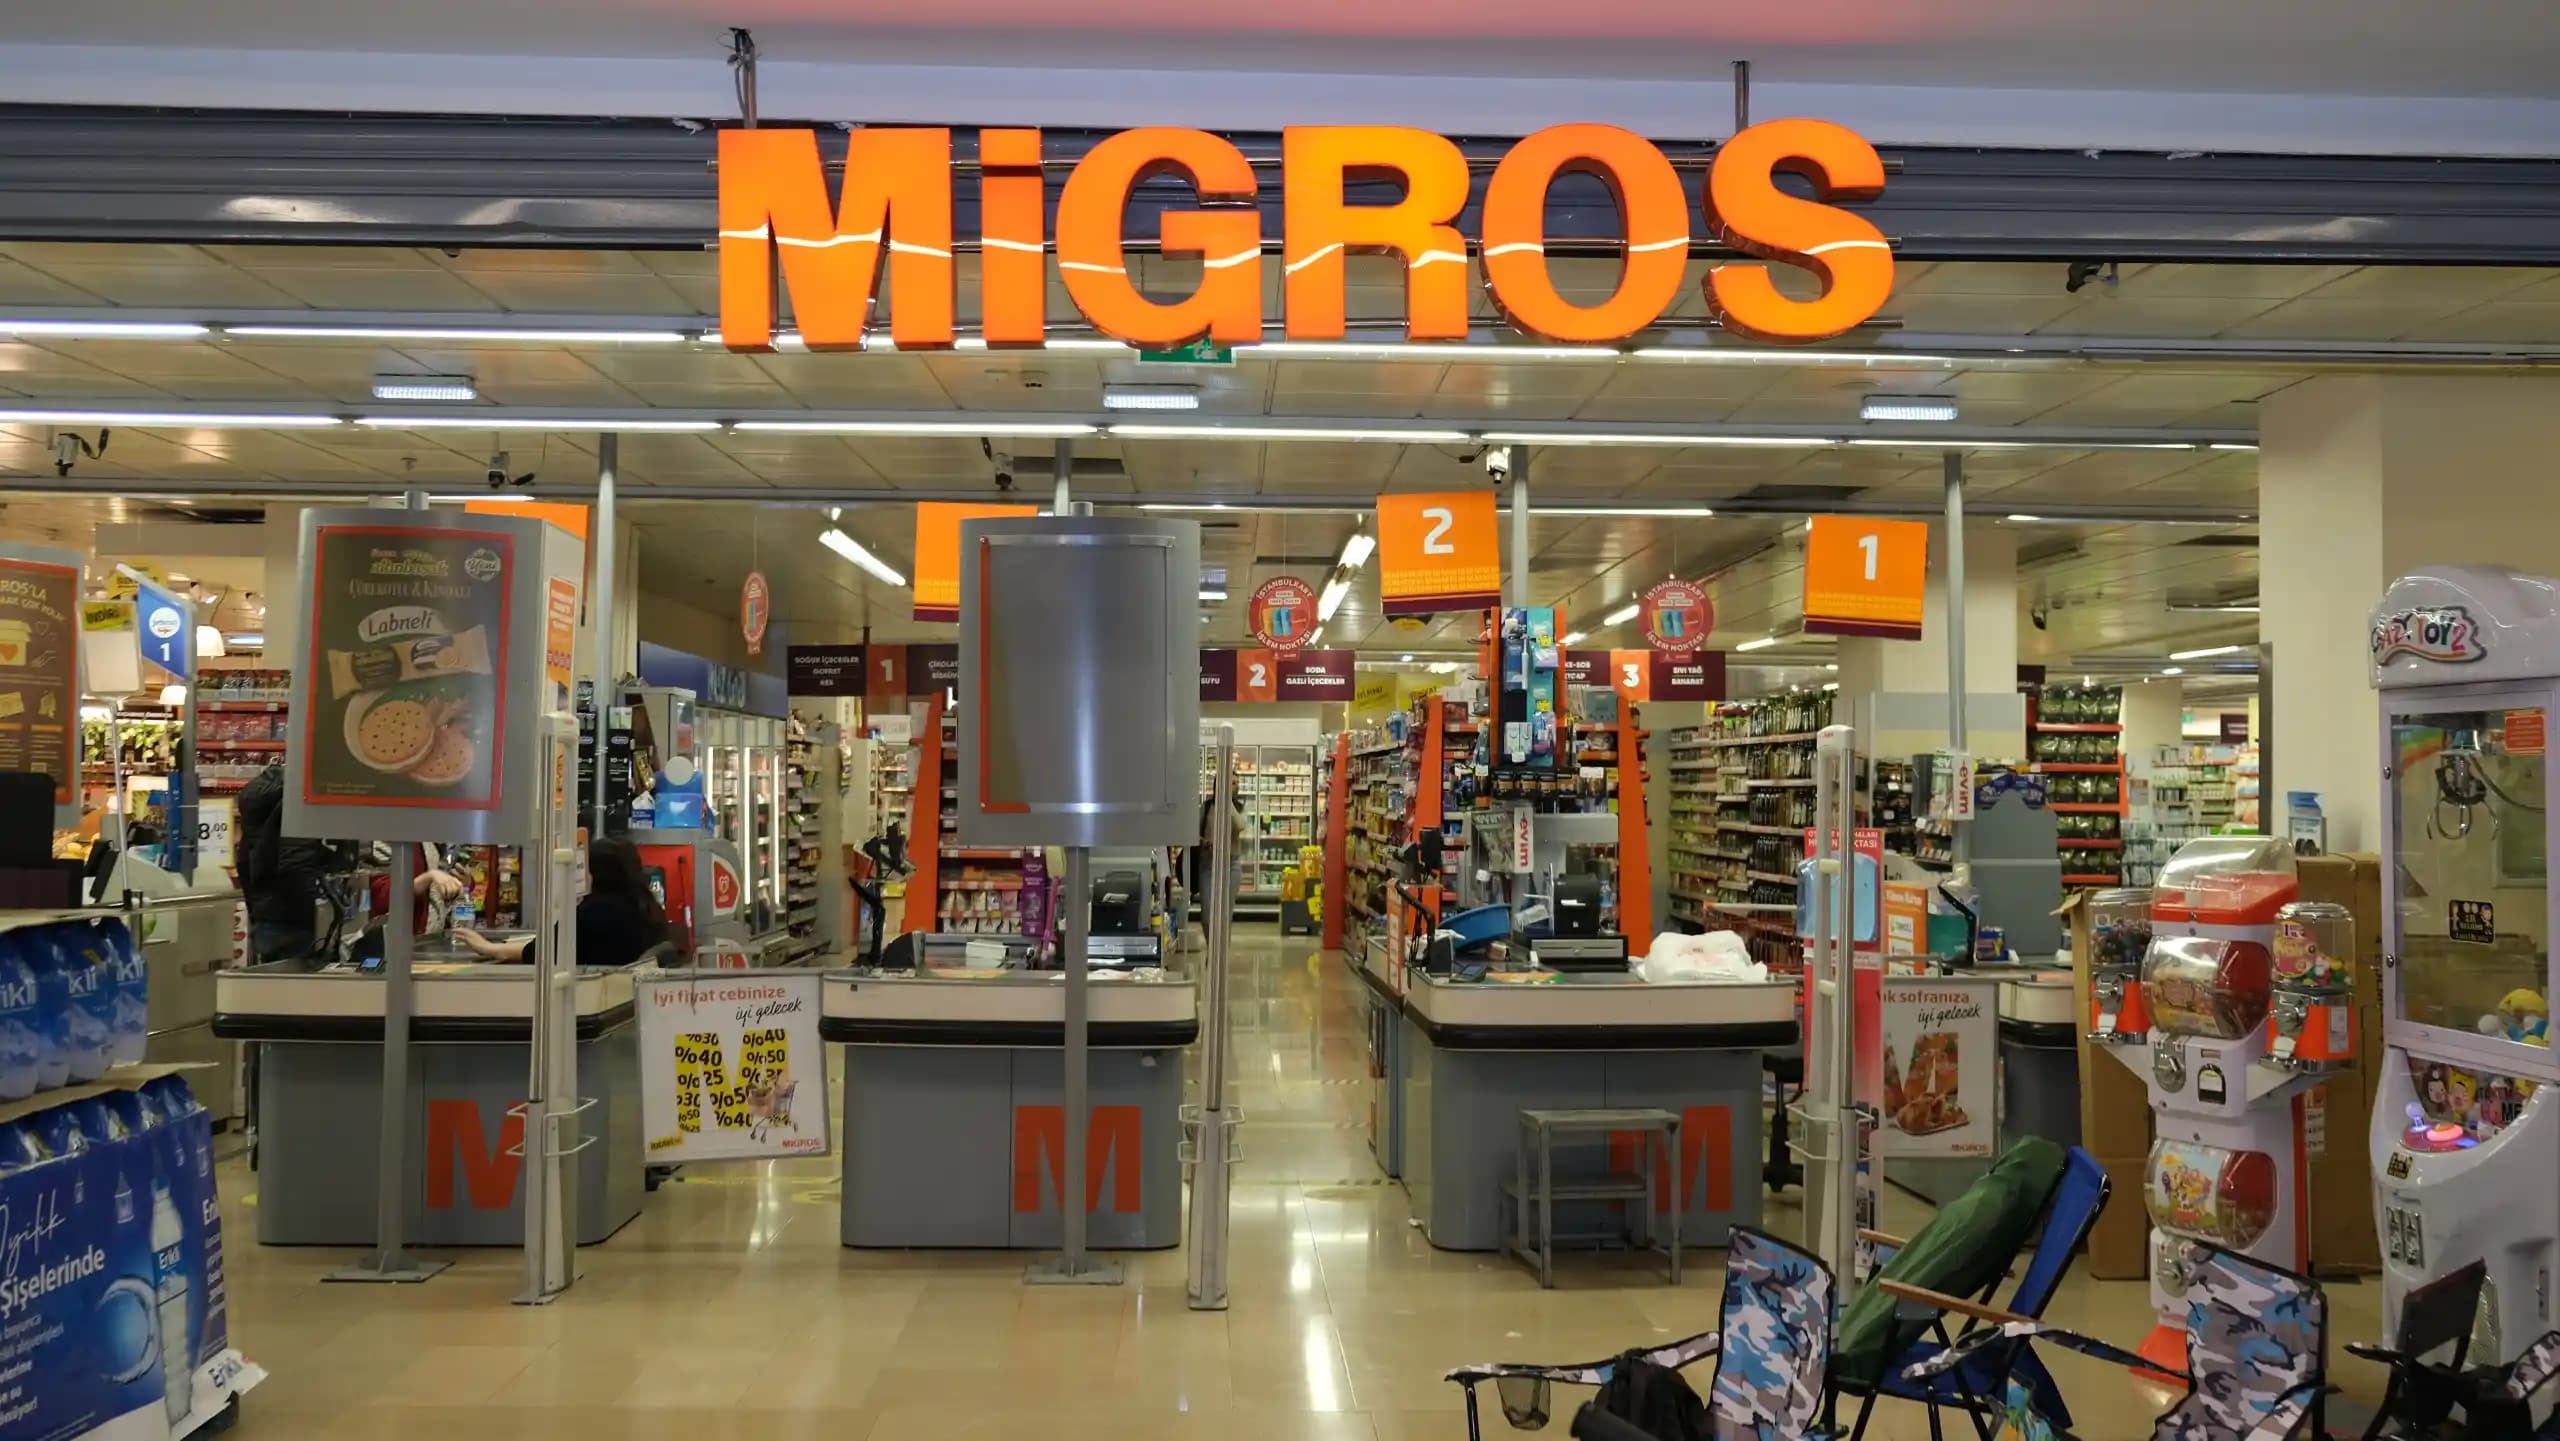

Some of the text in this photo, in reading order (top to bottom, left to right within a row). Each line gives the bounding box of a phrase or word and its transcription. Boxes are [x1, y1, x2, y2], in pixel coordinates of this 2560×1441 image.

[1422, 508, 1454, 554] 2
[1859, 535, 1878, 580] 1
[368, 611, 433, 636] Labneli
[160, 643, 170, 661] 1
[880, 659, 893, 682] 1
[1249, 664, 1266, 687] 2
[1305, 666, 1326, 674] SODA
[1622, 664, 1640, 688] 3
[1959, 766, 1968, 814] evim
[1520, 816, 1528, 867] evim
[719, 986, 786, 1001] cebinize
[1899, 990, 1970, 1004] sofranıza
[756, 998, 802, 1024] gelecek
[1937, 1002, 1981, 1028] gelecek
[743, 1028, 786, 1048] %40
[675, 1046, 723, 1067] %40
[0, 1244, 106, 1319] Şişelerinde
